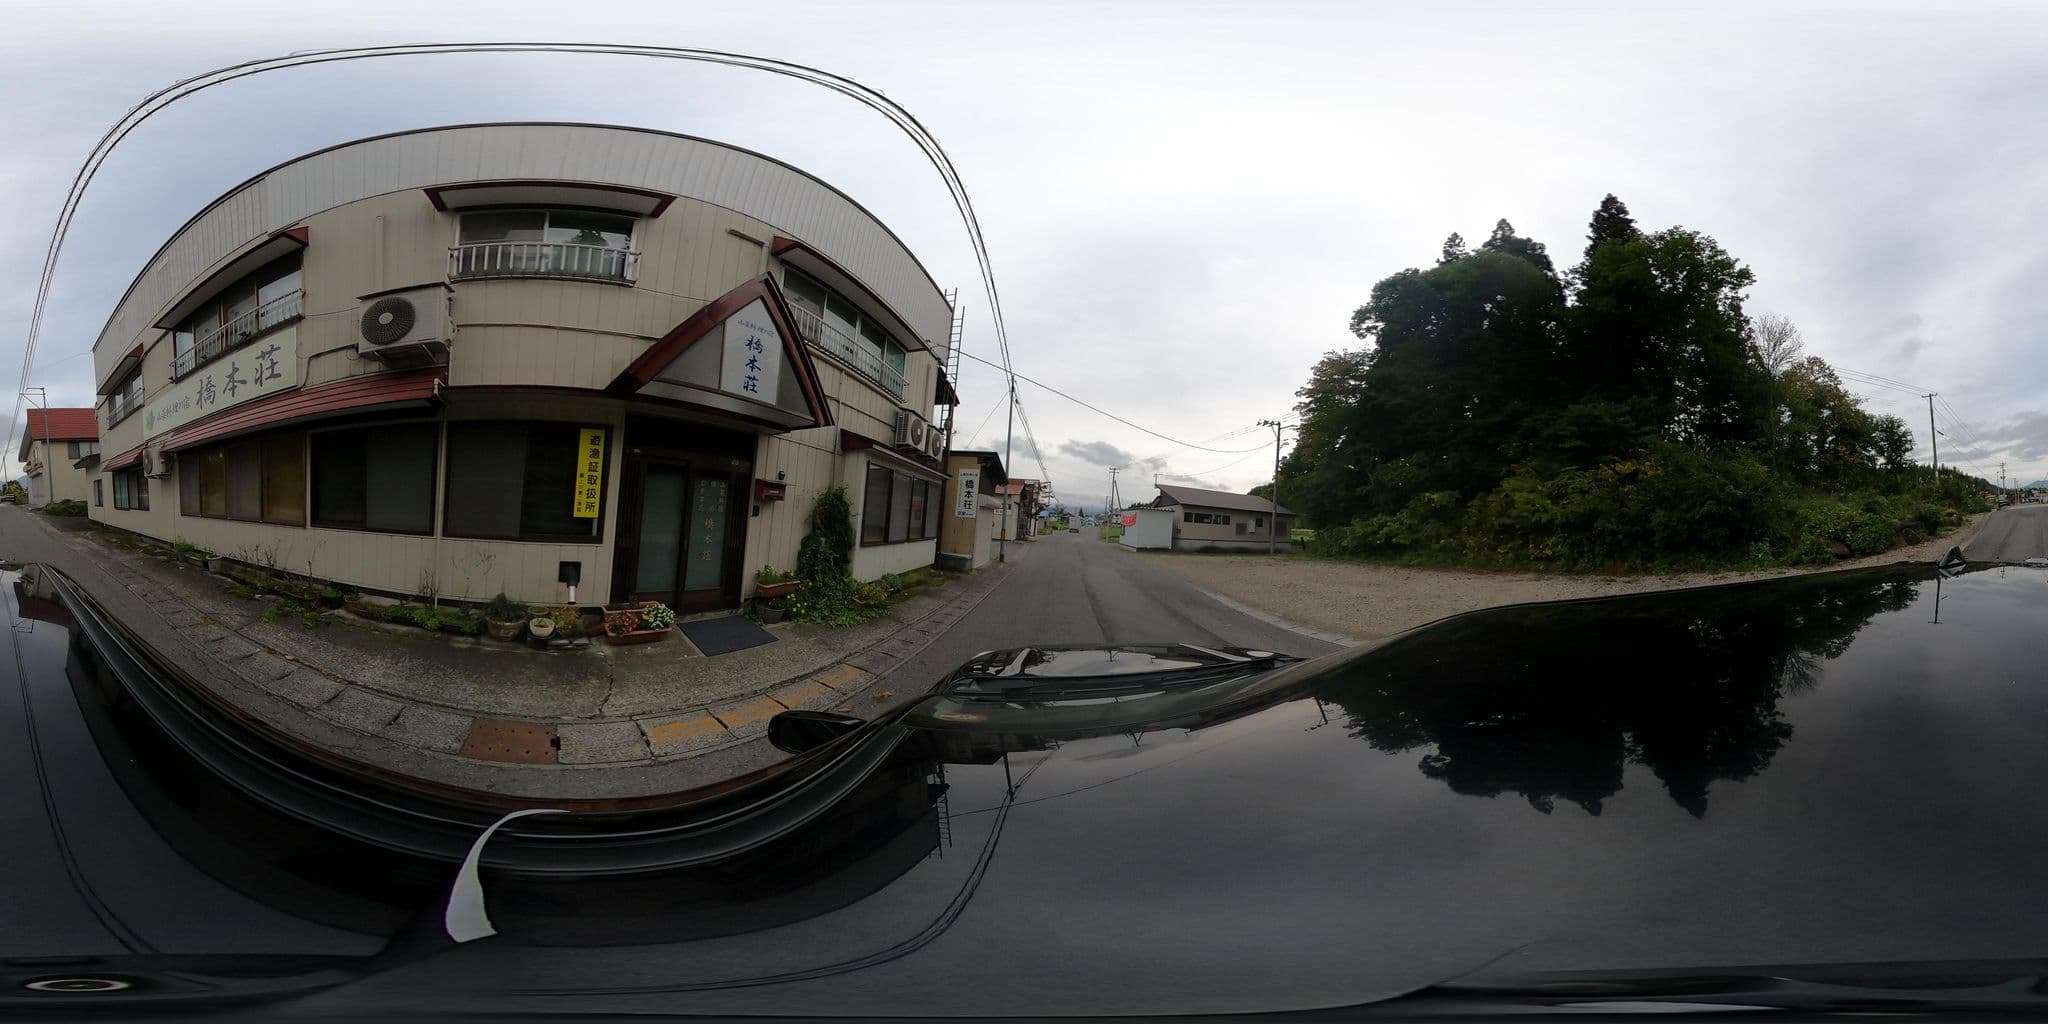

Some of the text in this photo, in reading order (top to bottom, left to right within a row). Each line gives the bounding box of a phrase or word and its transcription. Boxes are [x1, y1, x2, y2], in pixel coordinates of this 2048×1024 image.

[196, 343, 282, 410] 橋本荘
[743, 335, 763, 393] 橋本荘
[584, 434, 601, 513] 遊漁証取扱所
[963, 479, 974, 510] 橋本荘
